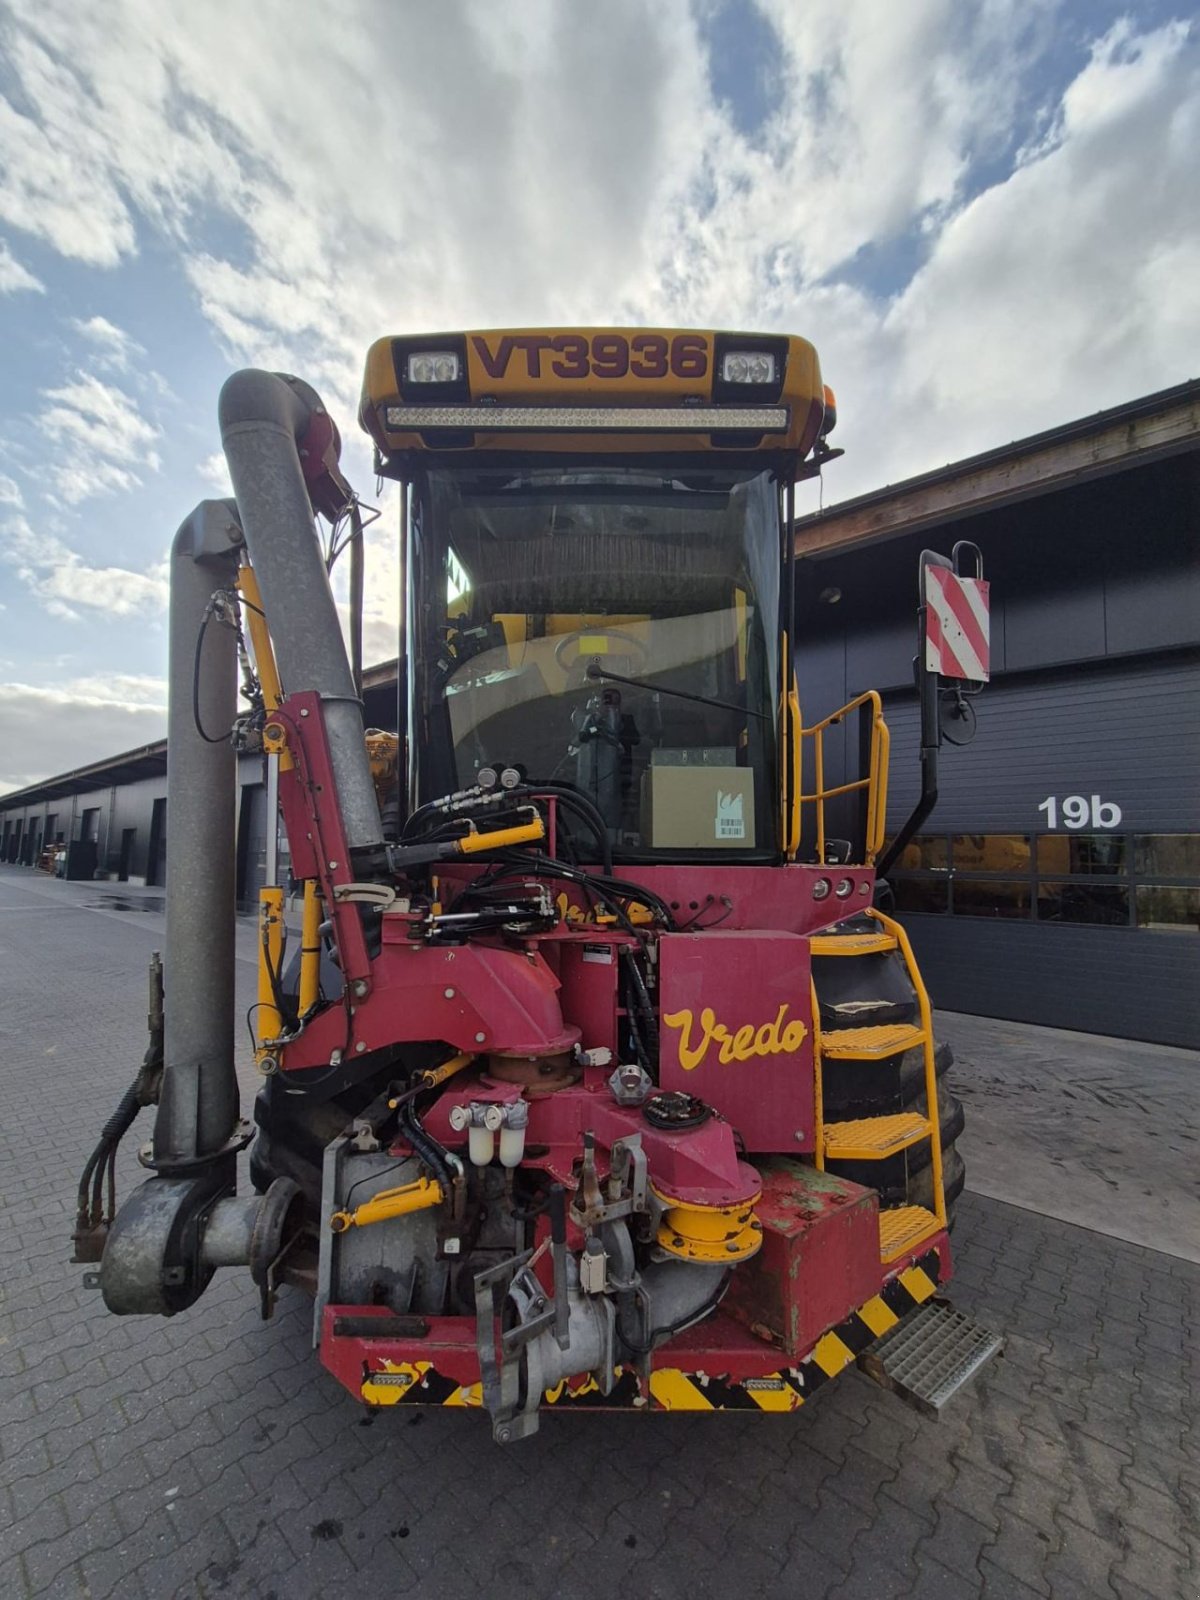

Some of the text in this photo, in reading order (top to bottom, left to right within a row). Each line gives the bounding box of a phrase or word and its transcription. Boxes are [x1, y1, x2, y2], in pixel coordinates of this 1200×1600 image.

[471, 334, 708, 379] VT3936
[1038, 795, 1122, 829] 19b
[663, 1003, 809, 1071] Vredo
